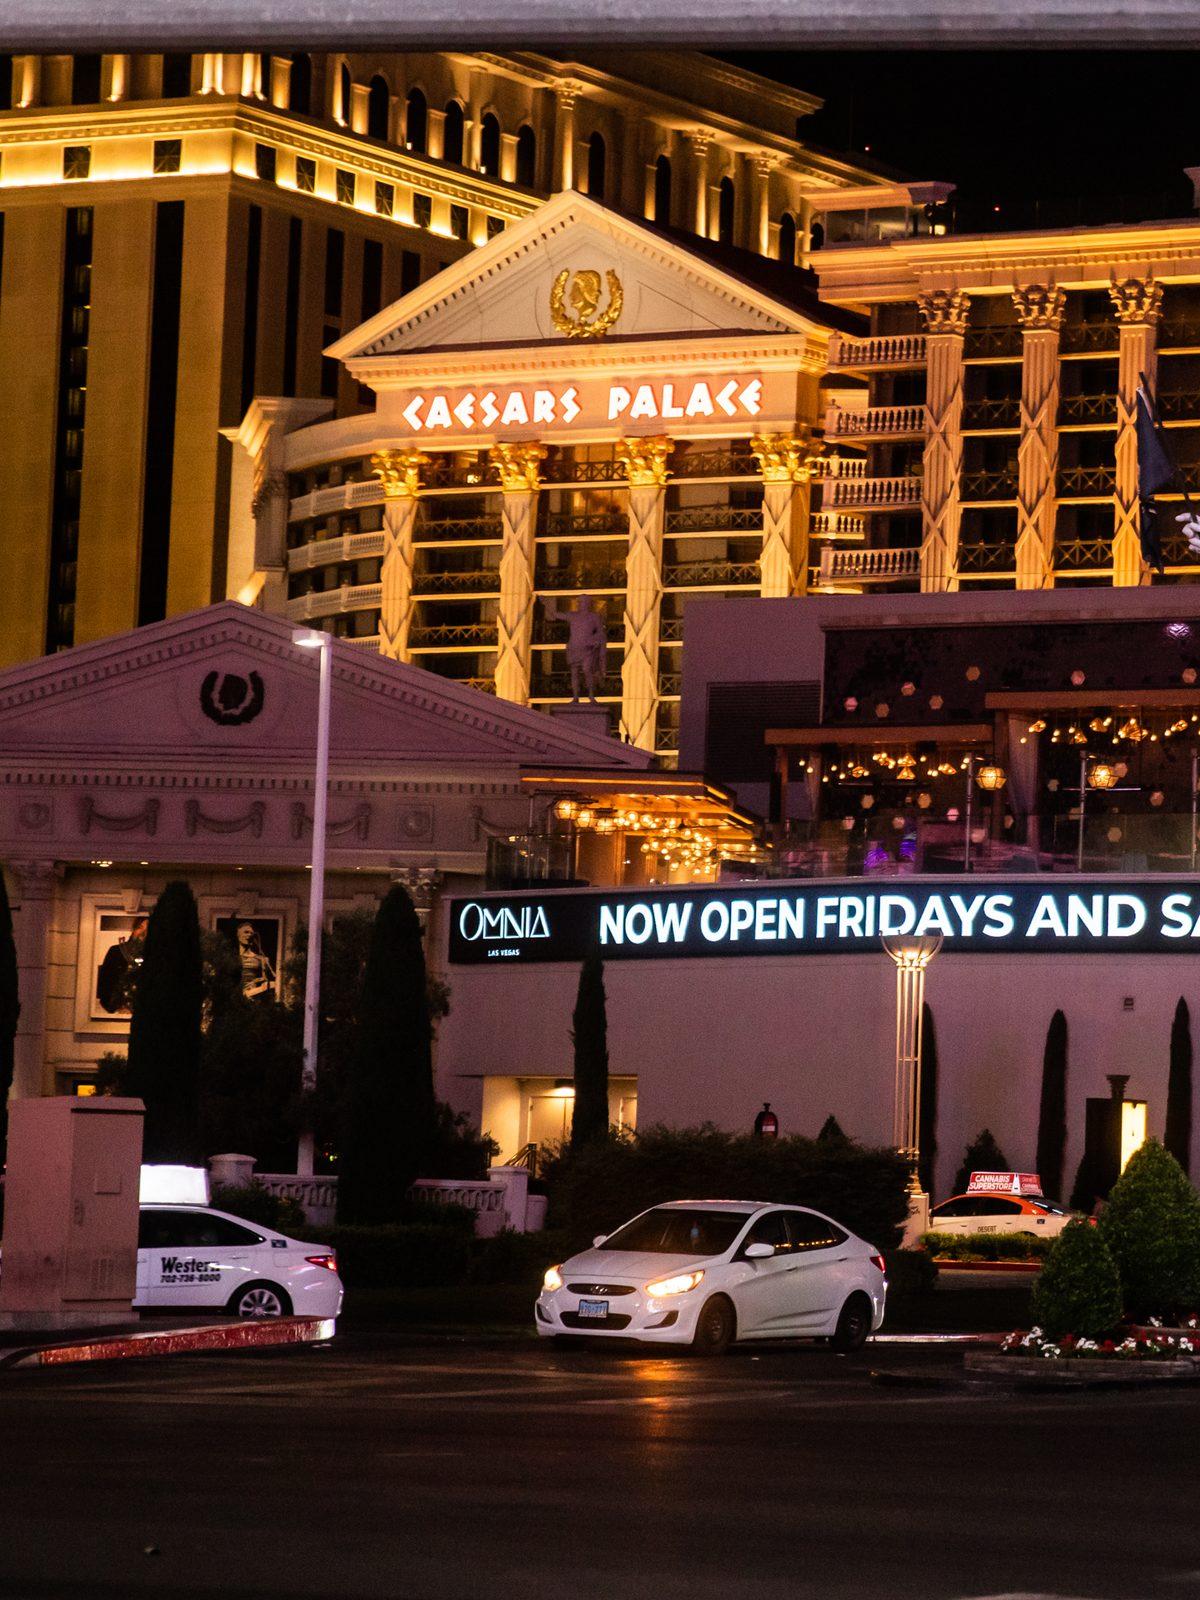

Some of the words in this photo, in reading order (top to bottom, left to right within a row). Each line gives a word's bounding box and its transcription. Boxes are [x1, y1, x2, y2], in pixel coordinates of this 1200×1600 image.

[402, 387, 581, 431] CAESARS
[607, 378, 764, 420] PALACE
[459, 902, 551, 942] OMNIA
[600, 902, 693, 945] NOW
[701, 898, 806, 942] OPEN
[816, 894, 1014, 940] FRIDAYS
[1025, 894, 1146, 938] AND
[969, 1182, 1013, 1191] SUPERSTORE
[975, 1174, 1010, 1183] CANNABIS
